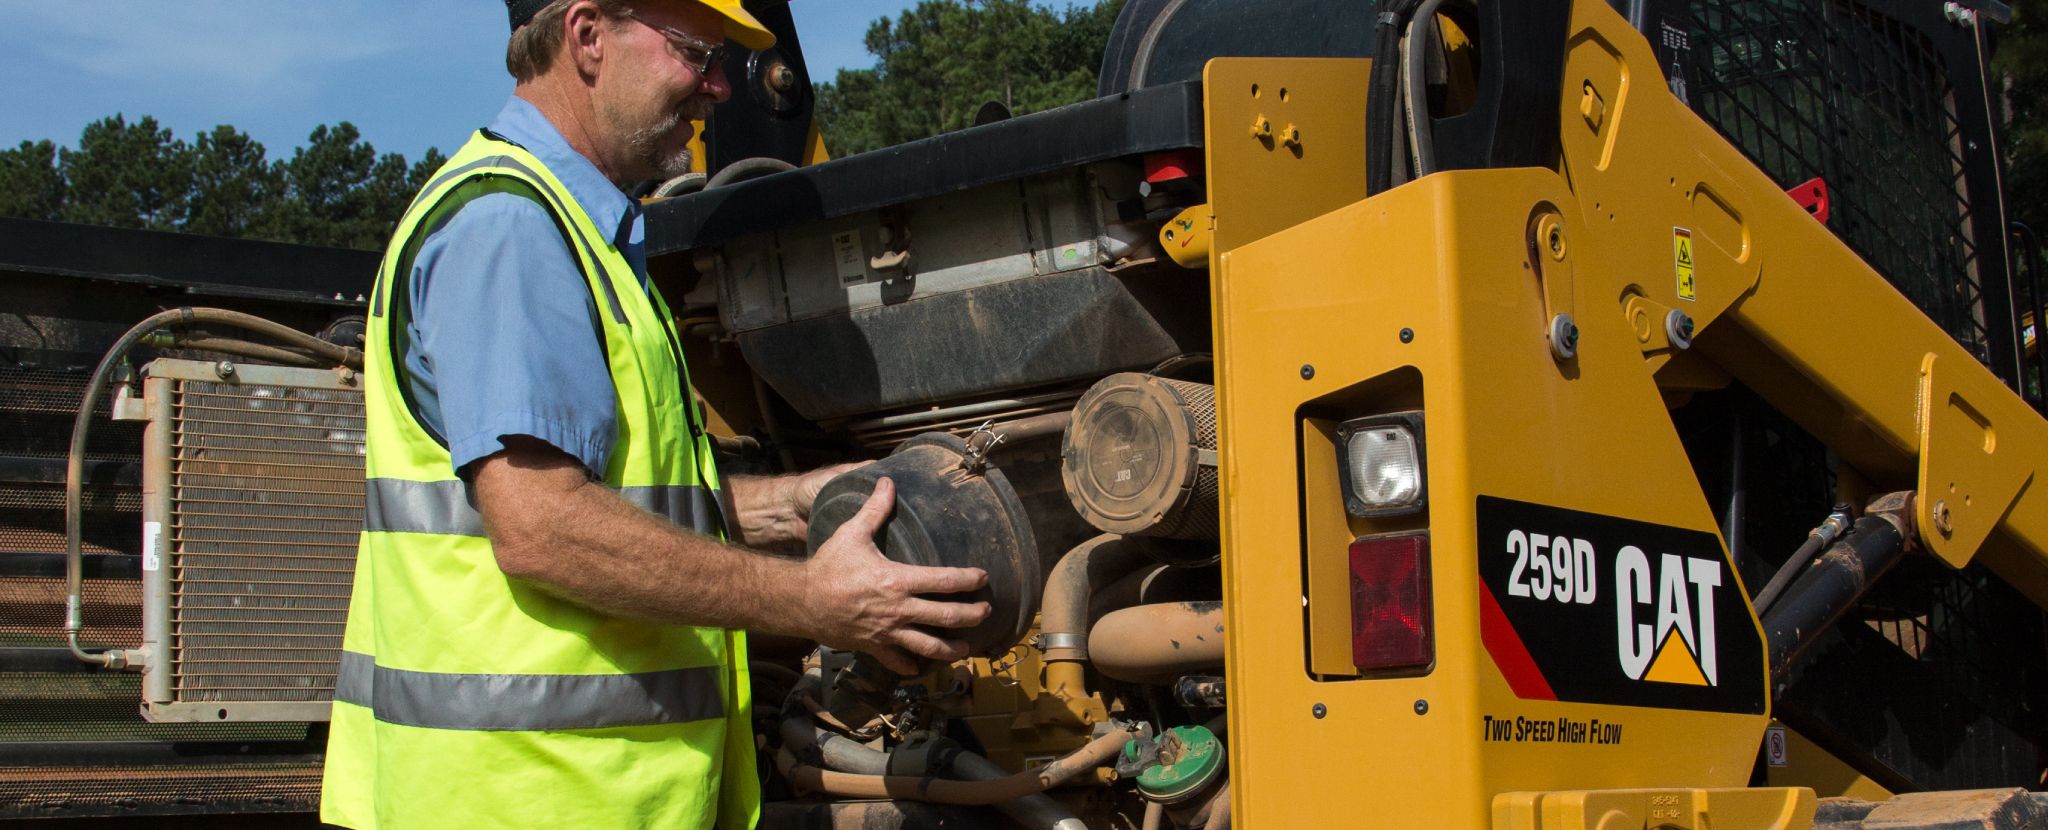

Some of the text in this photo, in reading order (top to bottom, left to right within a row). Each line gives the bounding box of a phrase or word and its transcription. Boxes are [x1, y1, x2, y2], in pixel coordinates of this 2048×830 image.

[1115, 469, 1131, 482] CAT
[1506, 529, 1597, 605] 259D
[1615, 545, 1722, 687] CAT
